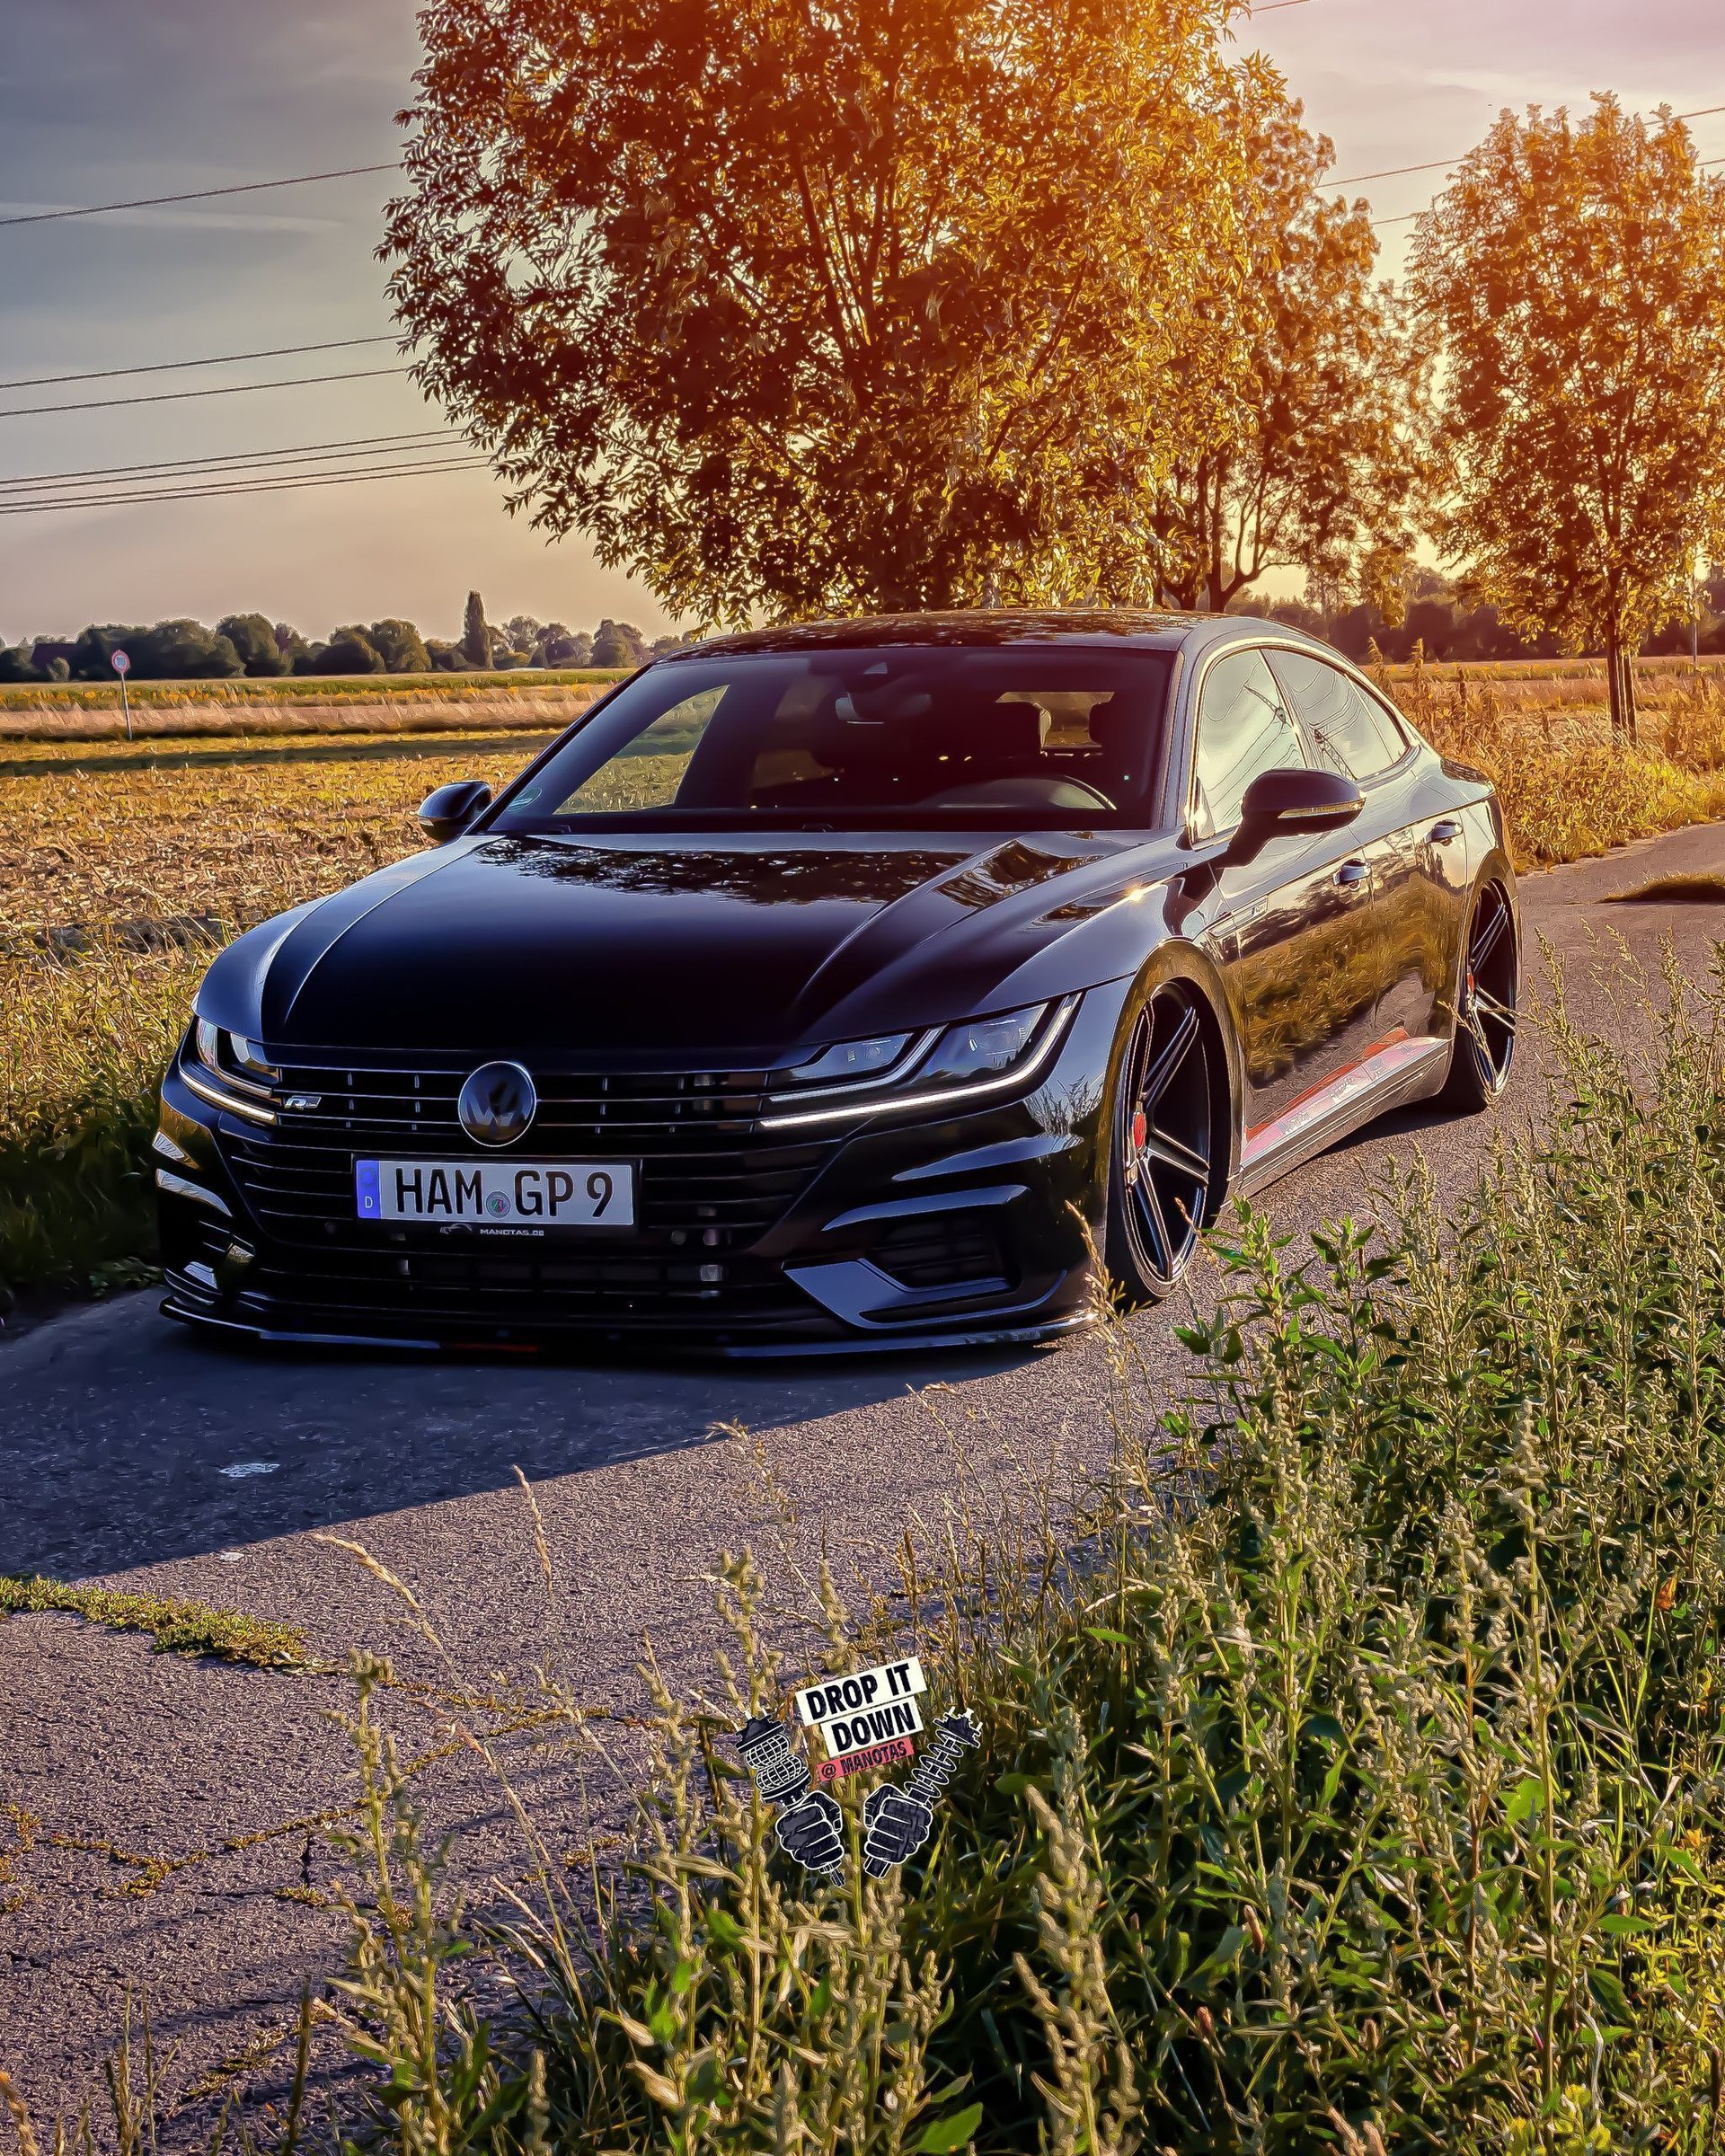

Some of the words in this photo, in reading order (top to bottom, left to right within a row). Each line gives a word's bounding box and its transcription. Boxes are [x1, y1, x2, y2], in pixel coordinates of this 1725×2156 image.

[365, 1196, 373, 1208] D
[395, 1168, 482, 1215] HAM
[514, 1171, 575, 1217] GP
[587, 1171, 614, 1218] 9
